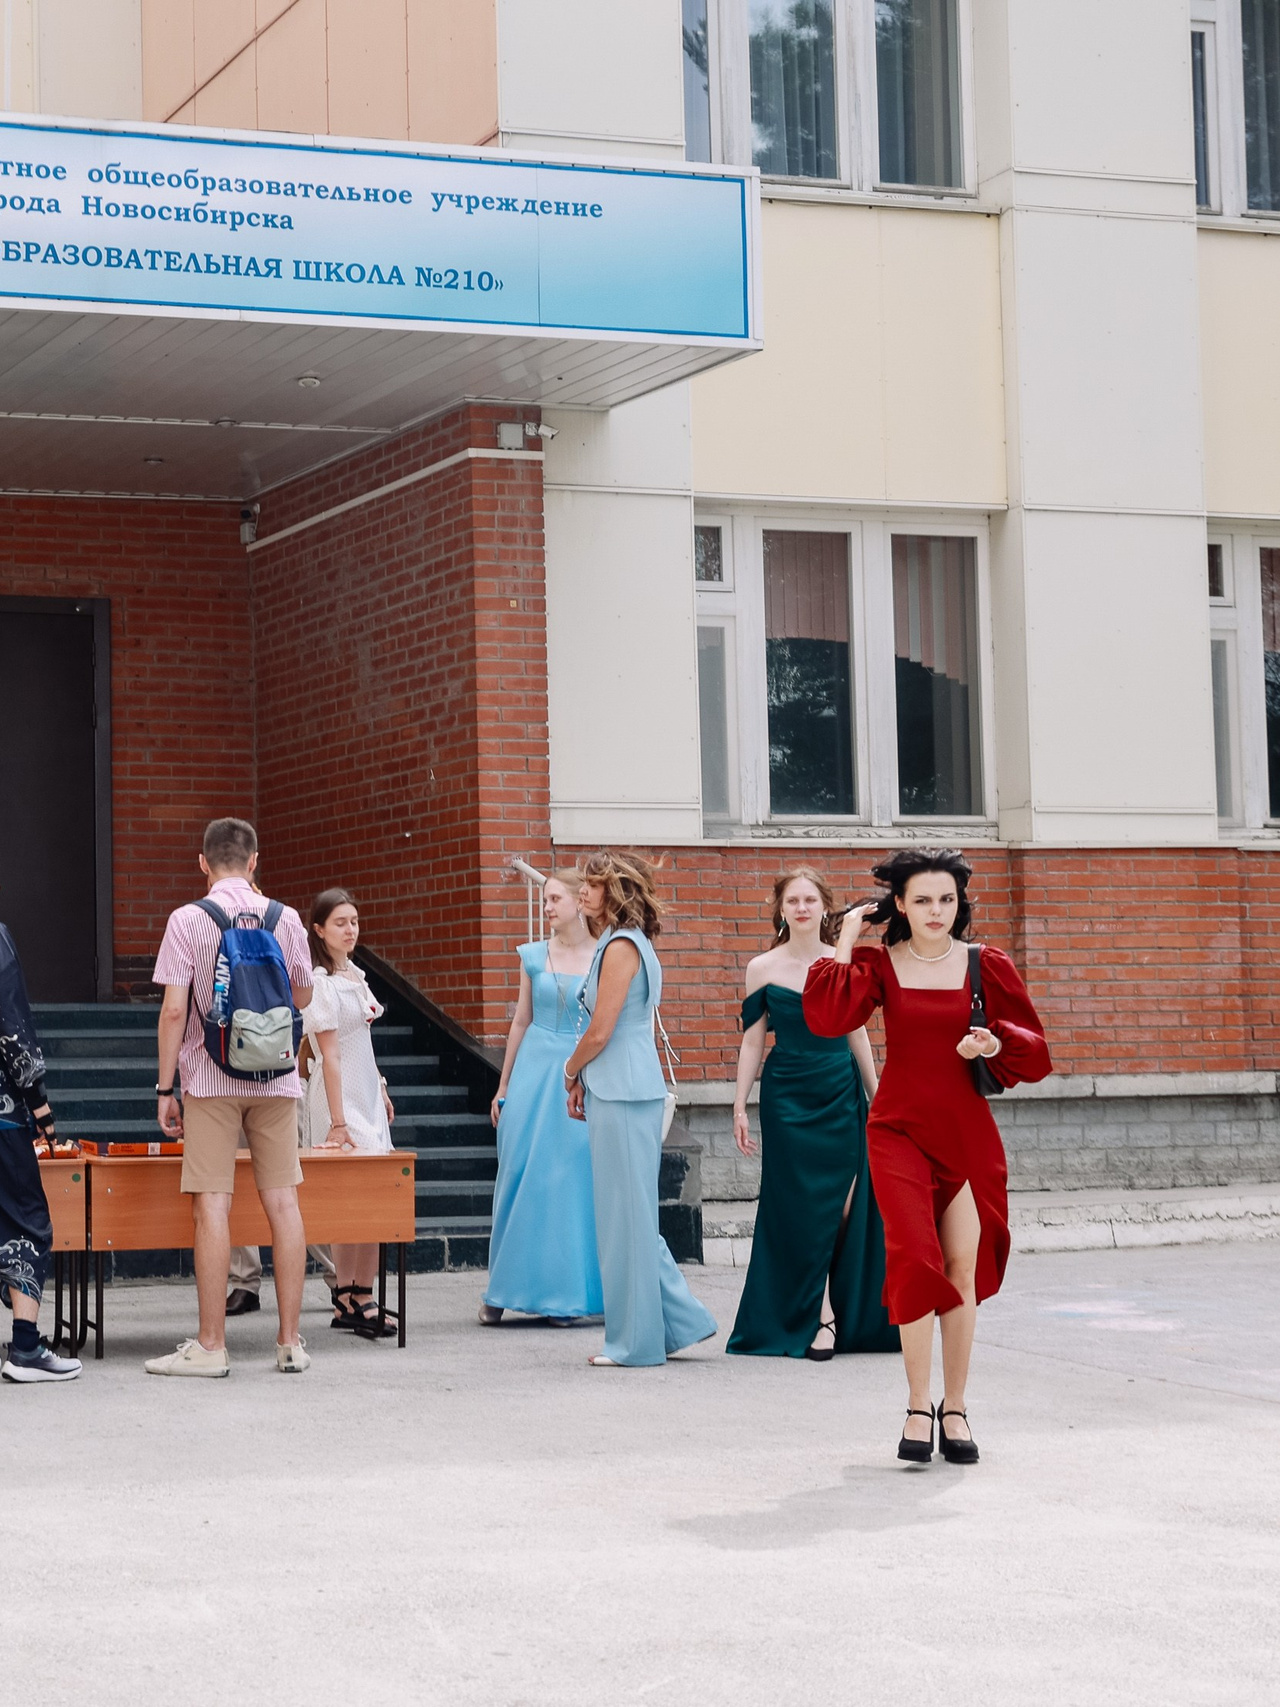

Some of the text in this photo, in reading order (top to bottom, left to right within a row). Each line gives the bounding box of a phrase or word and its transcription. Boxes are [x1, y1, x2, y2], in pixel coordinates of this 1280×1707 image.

[87, 163, 413, 205] общеобразовательное
[430, 190, 604, 219] учреждение
[81, 196, 295, 232] Новосибирска
[292, 260, 406, 286] ШКОЛА
[414, 266, 504, 292] №210»
